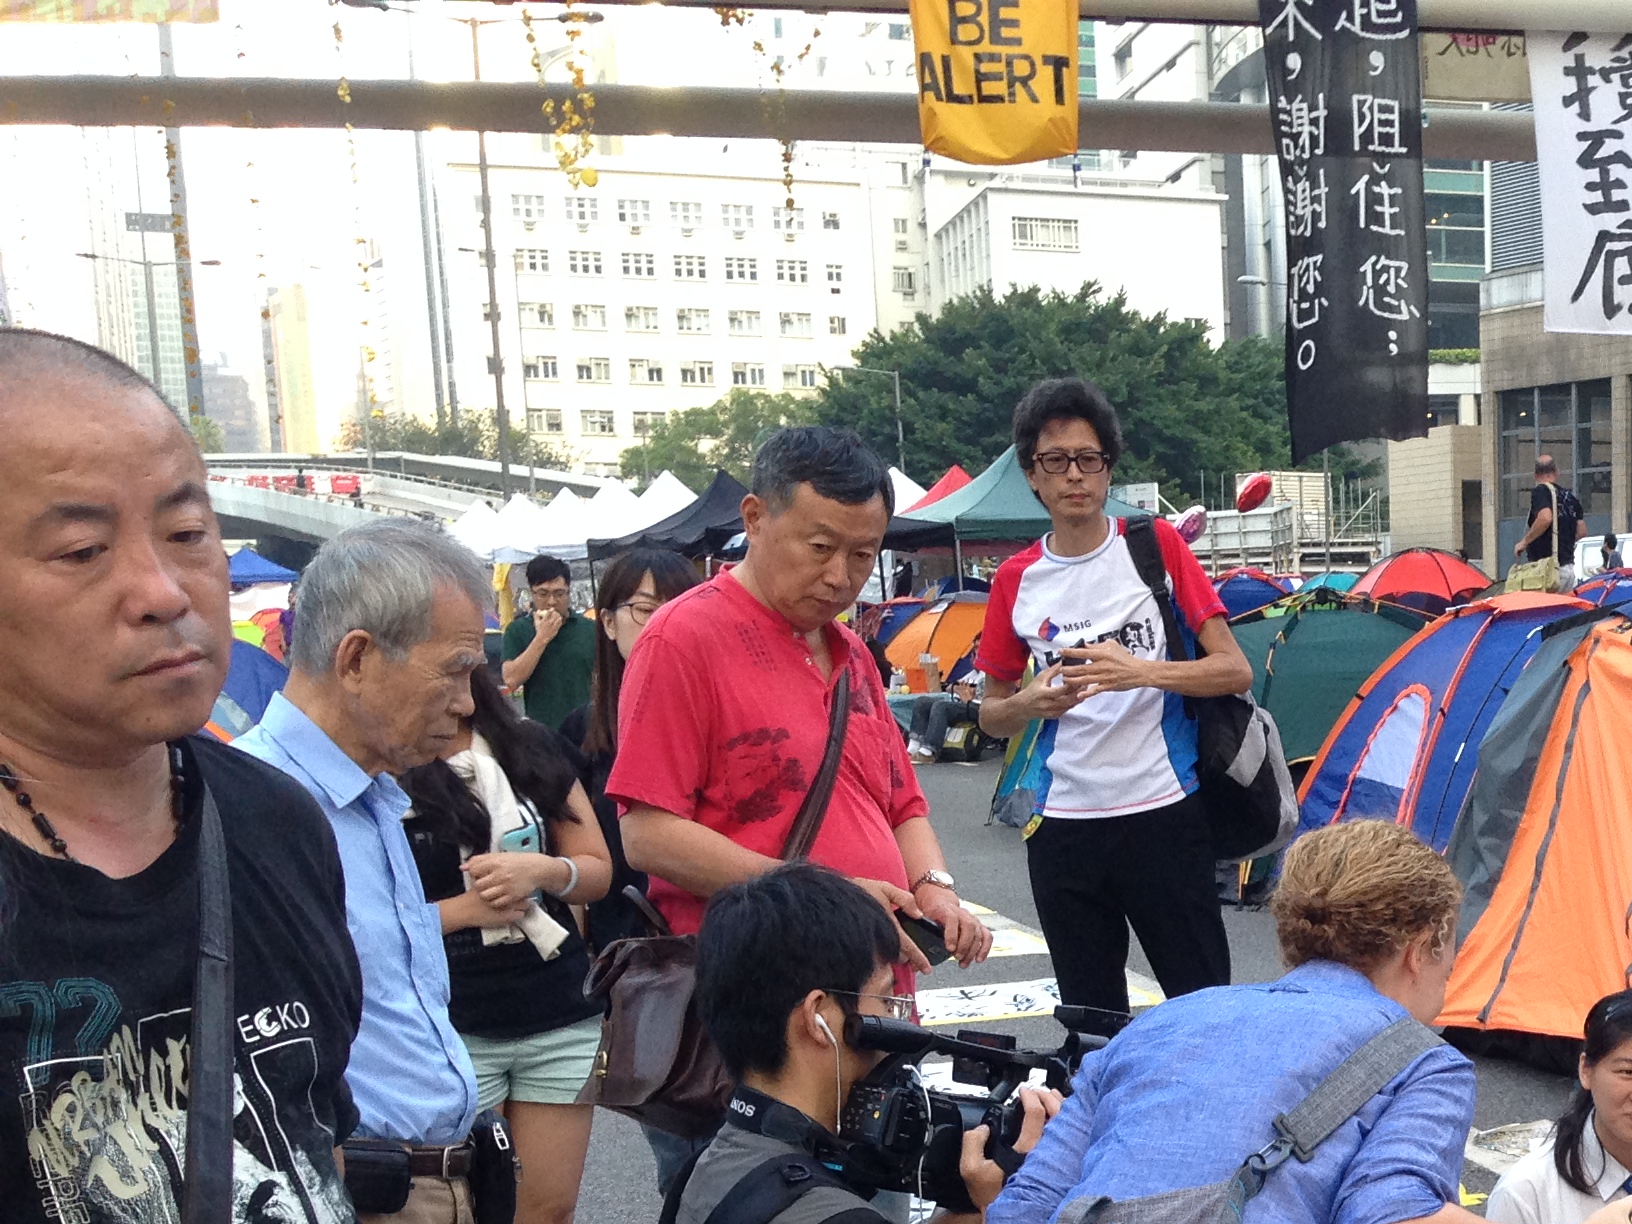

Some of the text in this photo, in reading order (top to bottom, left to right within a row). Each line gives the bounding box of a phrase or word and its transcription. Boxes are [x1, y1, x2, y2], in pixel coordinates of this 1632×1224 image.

[948, 0, 1023, 47] BE
[919, 52, 1071, 105] ALERT
[1063, 619, 1092, 633] MSIG
[236, 1001, 310, 1043] ECKO
